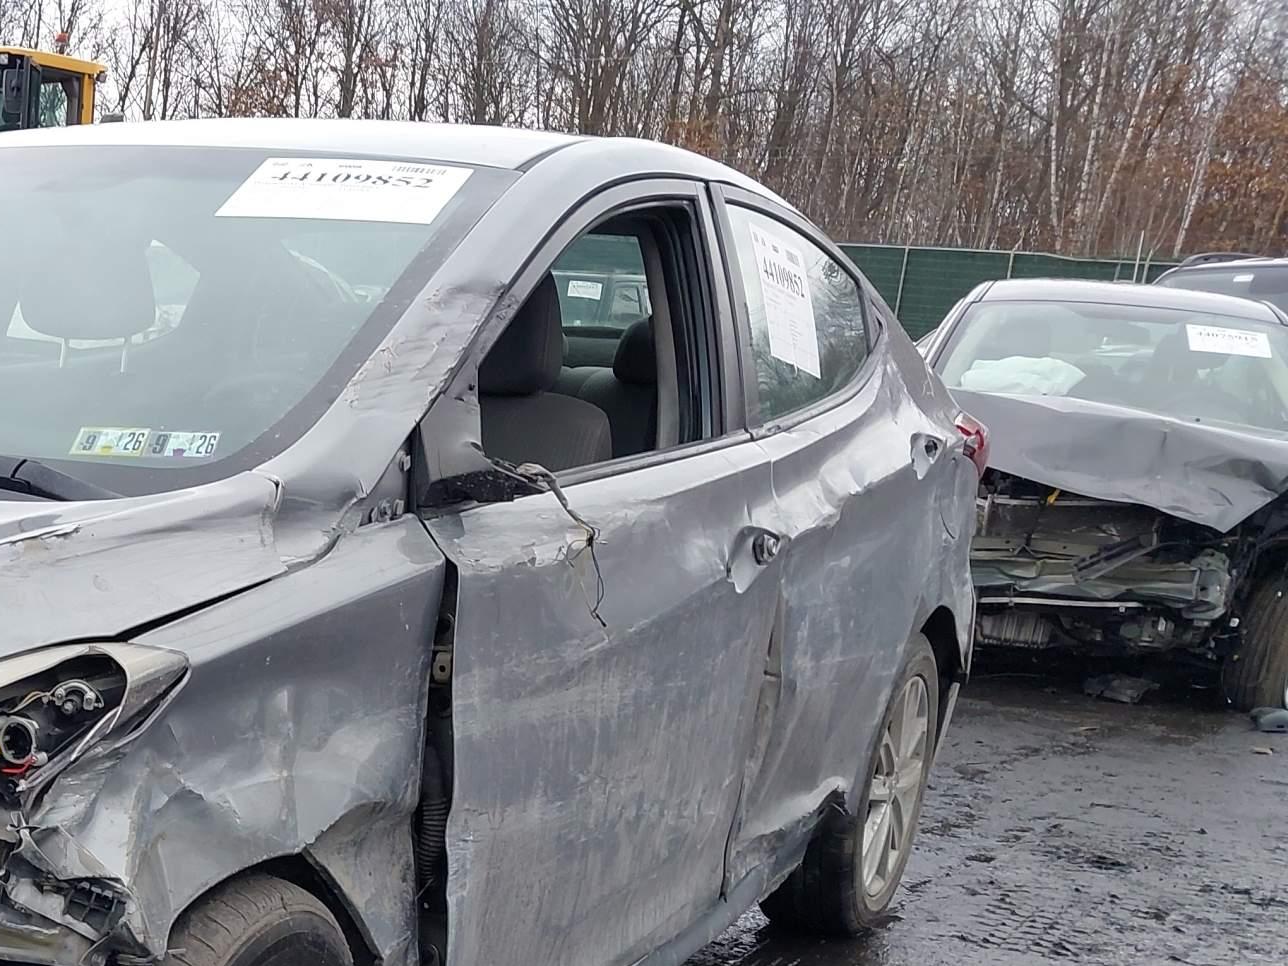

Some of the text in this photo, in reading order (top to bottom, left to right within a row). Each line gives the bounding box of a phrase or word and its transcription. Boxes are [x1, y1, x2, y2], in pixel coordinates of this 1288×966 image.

[763, 256, 806, 299] 44109852
[123, 432, 145, 451] 26
[195, 434, 217, 454] 26
